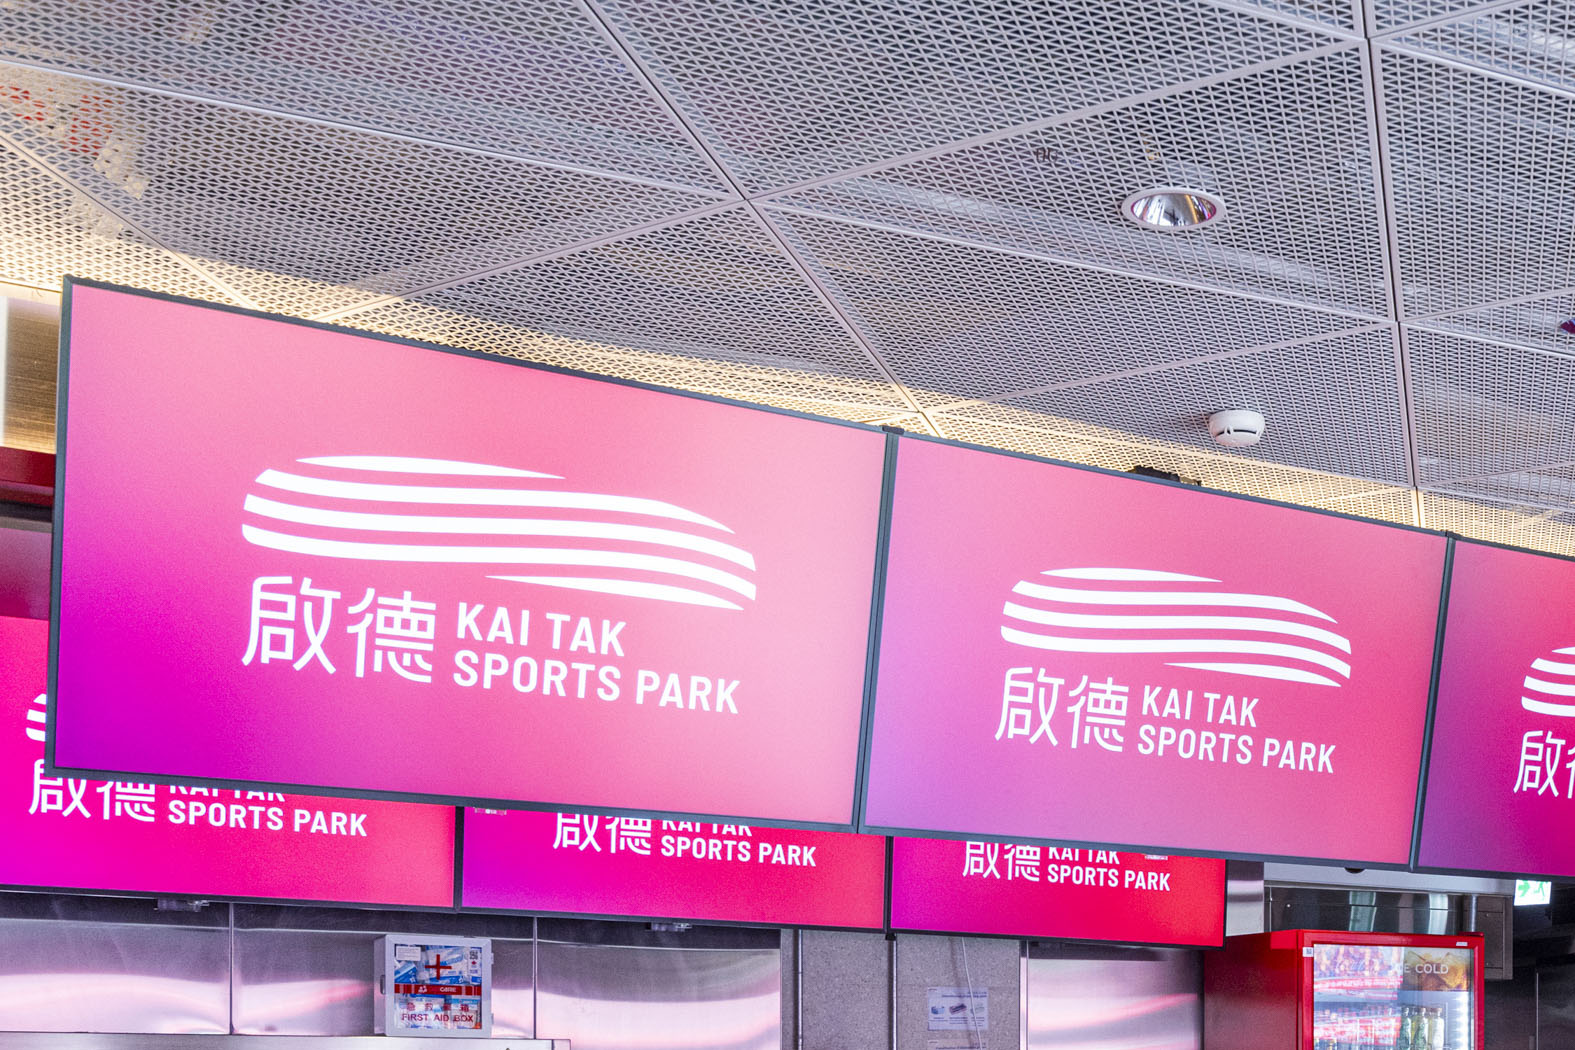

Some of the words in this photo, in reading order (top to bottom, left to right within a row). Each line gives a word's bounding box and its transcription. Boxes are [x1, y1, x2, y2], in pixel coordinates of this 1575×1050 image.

[241, 575, 437, 683] 啟德
[456, 602, 530, 646] KAI
[546, 612, 626, 657] TAK
[453, 649, 622, 702] SPORTS
[636, 670, 741, 714] PARK
[994, 667, 1129, 752] 啟德
[1142, 685, 1193, 720] KAI
[1203, 692, 1260, 727] TAK
[1137, 725, 1254, 765] SPORTS
[1262, 738, 1337, 774] PARK
[168, 800, 284, 831] SPORTS
[293, 809, 368, 837] PARK
[661, 835, 752, 862] SPORTS
[758, 842, 816, 867] PARK
[1047, 864, 1119, 887] SPORTS
[1124, 870, 1171, 891] PARK
[1415, 963, 1449, 974] COLD
[401, 1013, 428, 1021] FIRST
[433, 1014, 449, 1022] AID
[453, 1015, 473, 1023] BOX
